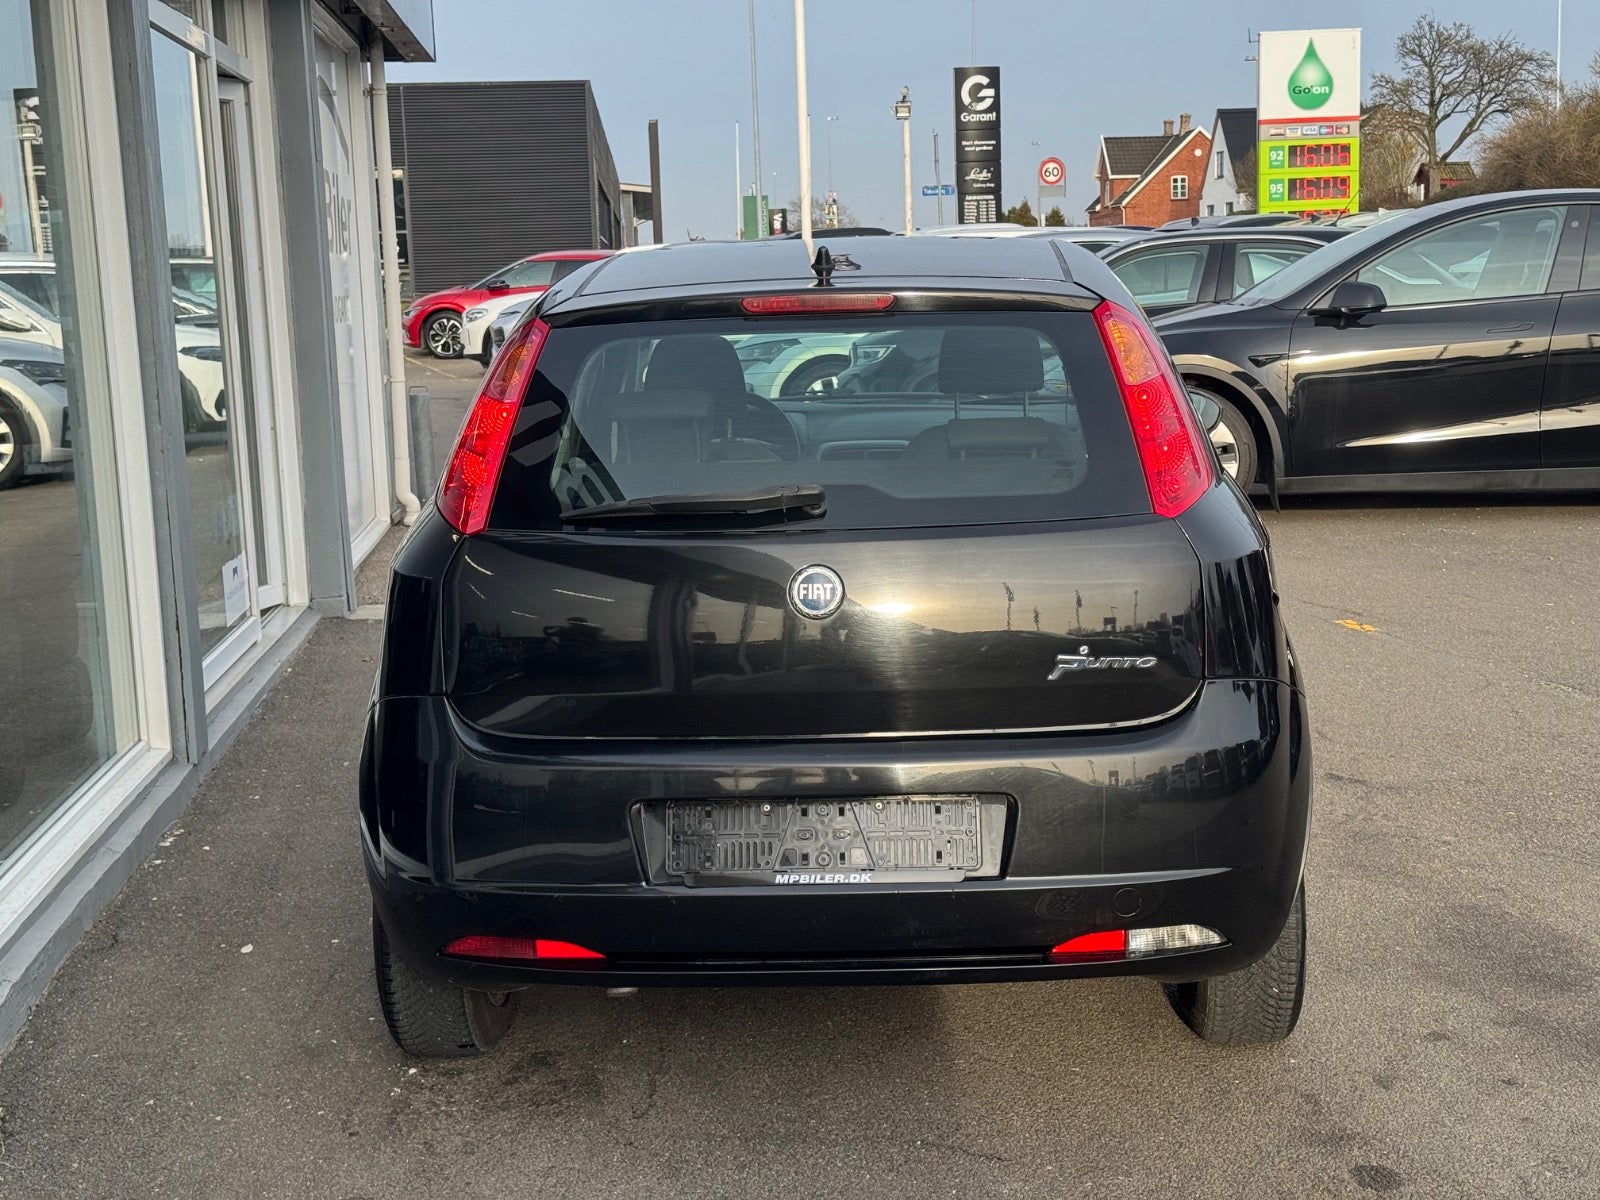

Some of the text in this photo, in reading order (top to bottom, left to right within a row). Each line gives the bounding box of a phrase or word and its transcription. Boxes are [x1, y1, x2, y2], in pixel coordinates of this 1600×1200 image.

[1292, 85, 1329, 95] Go'on
[960, 111, 996, 122] Garant
[1269, 150, 1284, 161] 92
[1044, 166, 1060, 178] 60
[1269, 183, 1284, 194] 95
[323, 168, 352, 256] Biler
[799, 583, 834, 600] FIAT
[774, 873, 872, 884] MPBILER.DK
